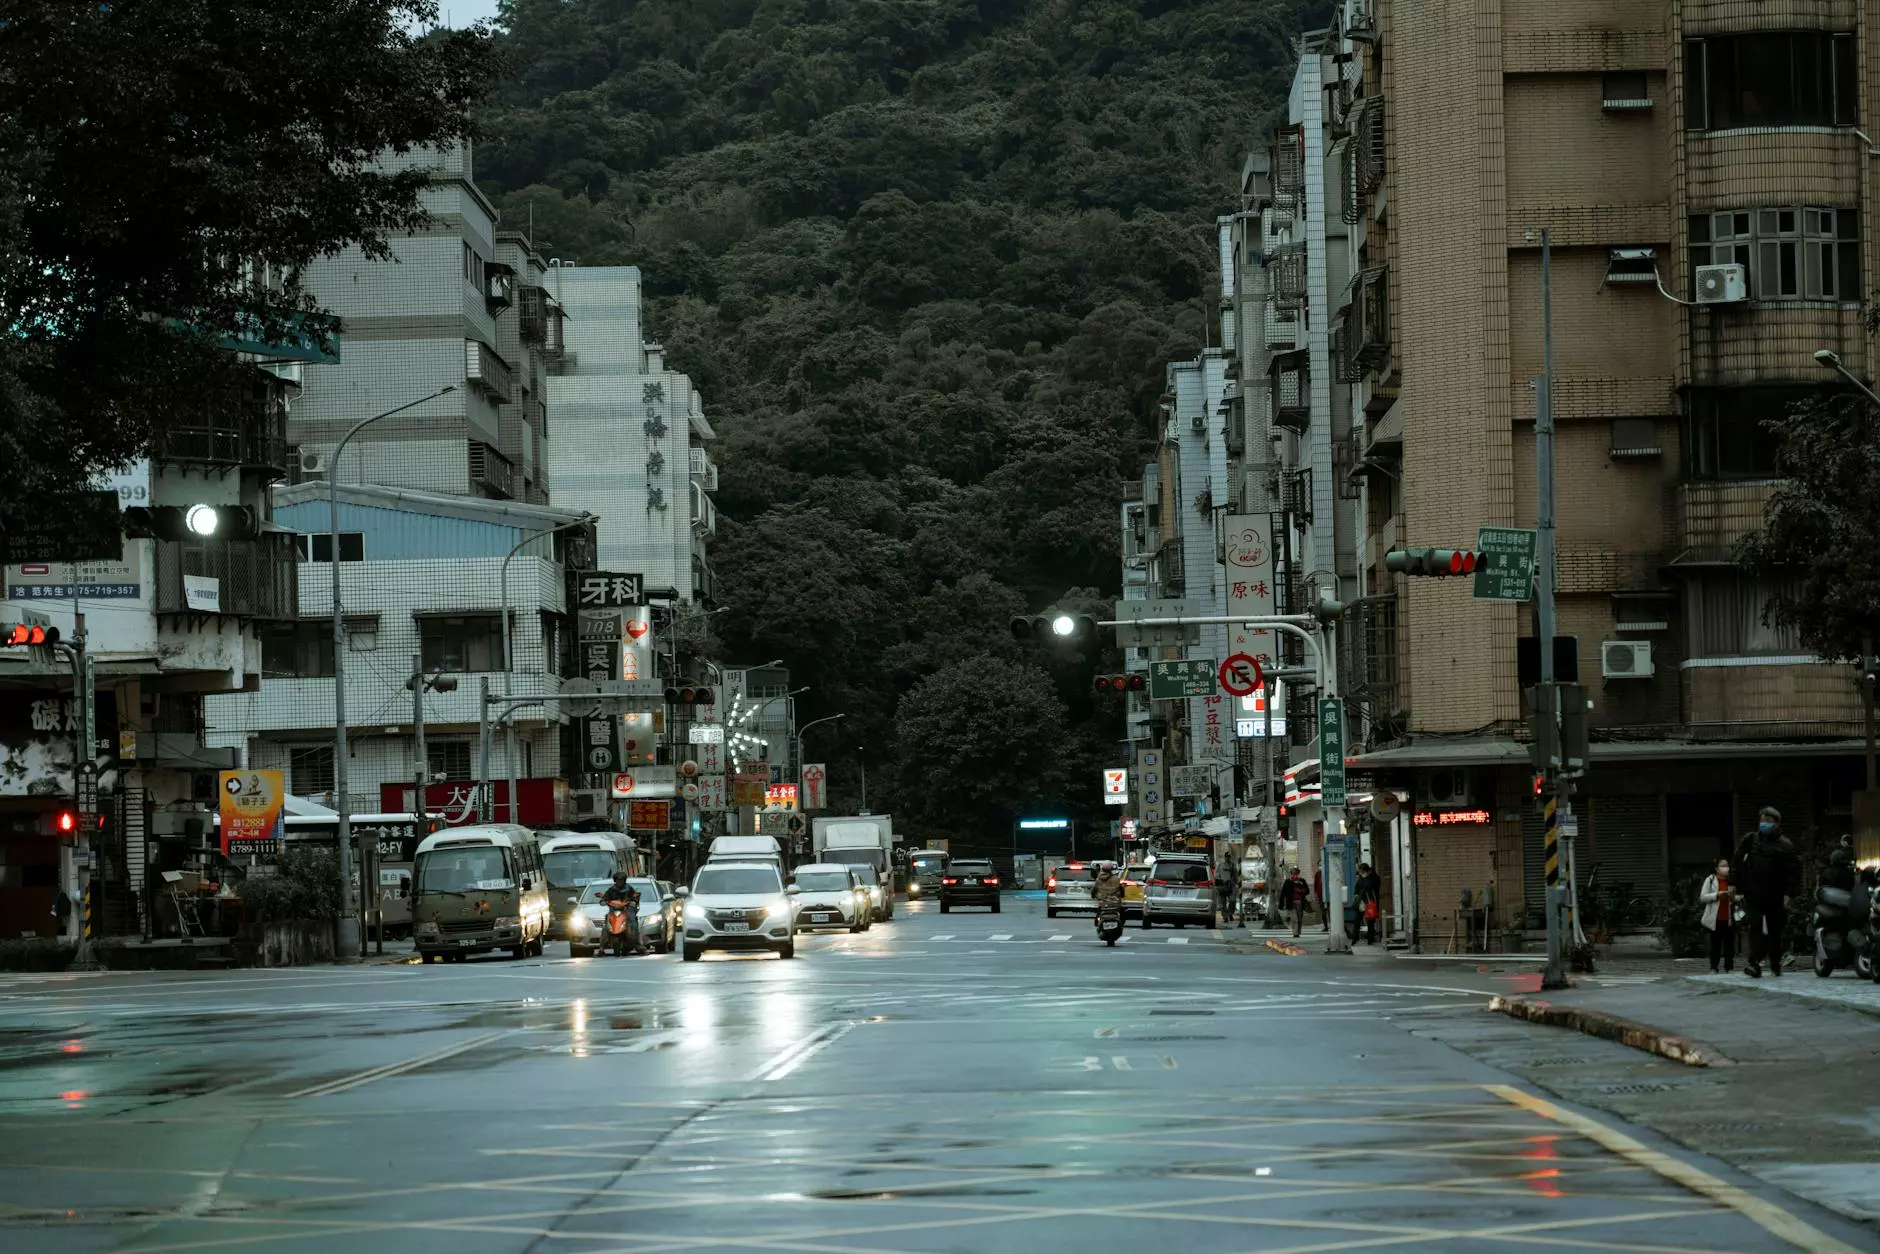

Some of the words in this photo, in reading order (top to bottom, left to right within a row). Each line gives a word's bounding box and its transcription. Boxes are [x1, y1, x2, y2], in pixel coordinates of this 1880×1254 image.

[1499, 555, 1528, 568] 興街
[32, 587, 63, 596] 范先生
[67, 586, 133, 596] 075-719-357
[581, 577, 639, 604] 牙科
[1231, 580, 1270, 599] 原味
[586, 621, 614, 633] 108
[1157, 662, 1208, 676] 吳興街
[1203, 695, 1222, 744] 和豆漿
[1324, 711, 1339, 765] 吳興街
[231, 844, 274, 853] 8789-1111
